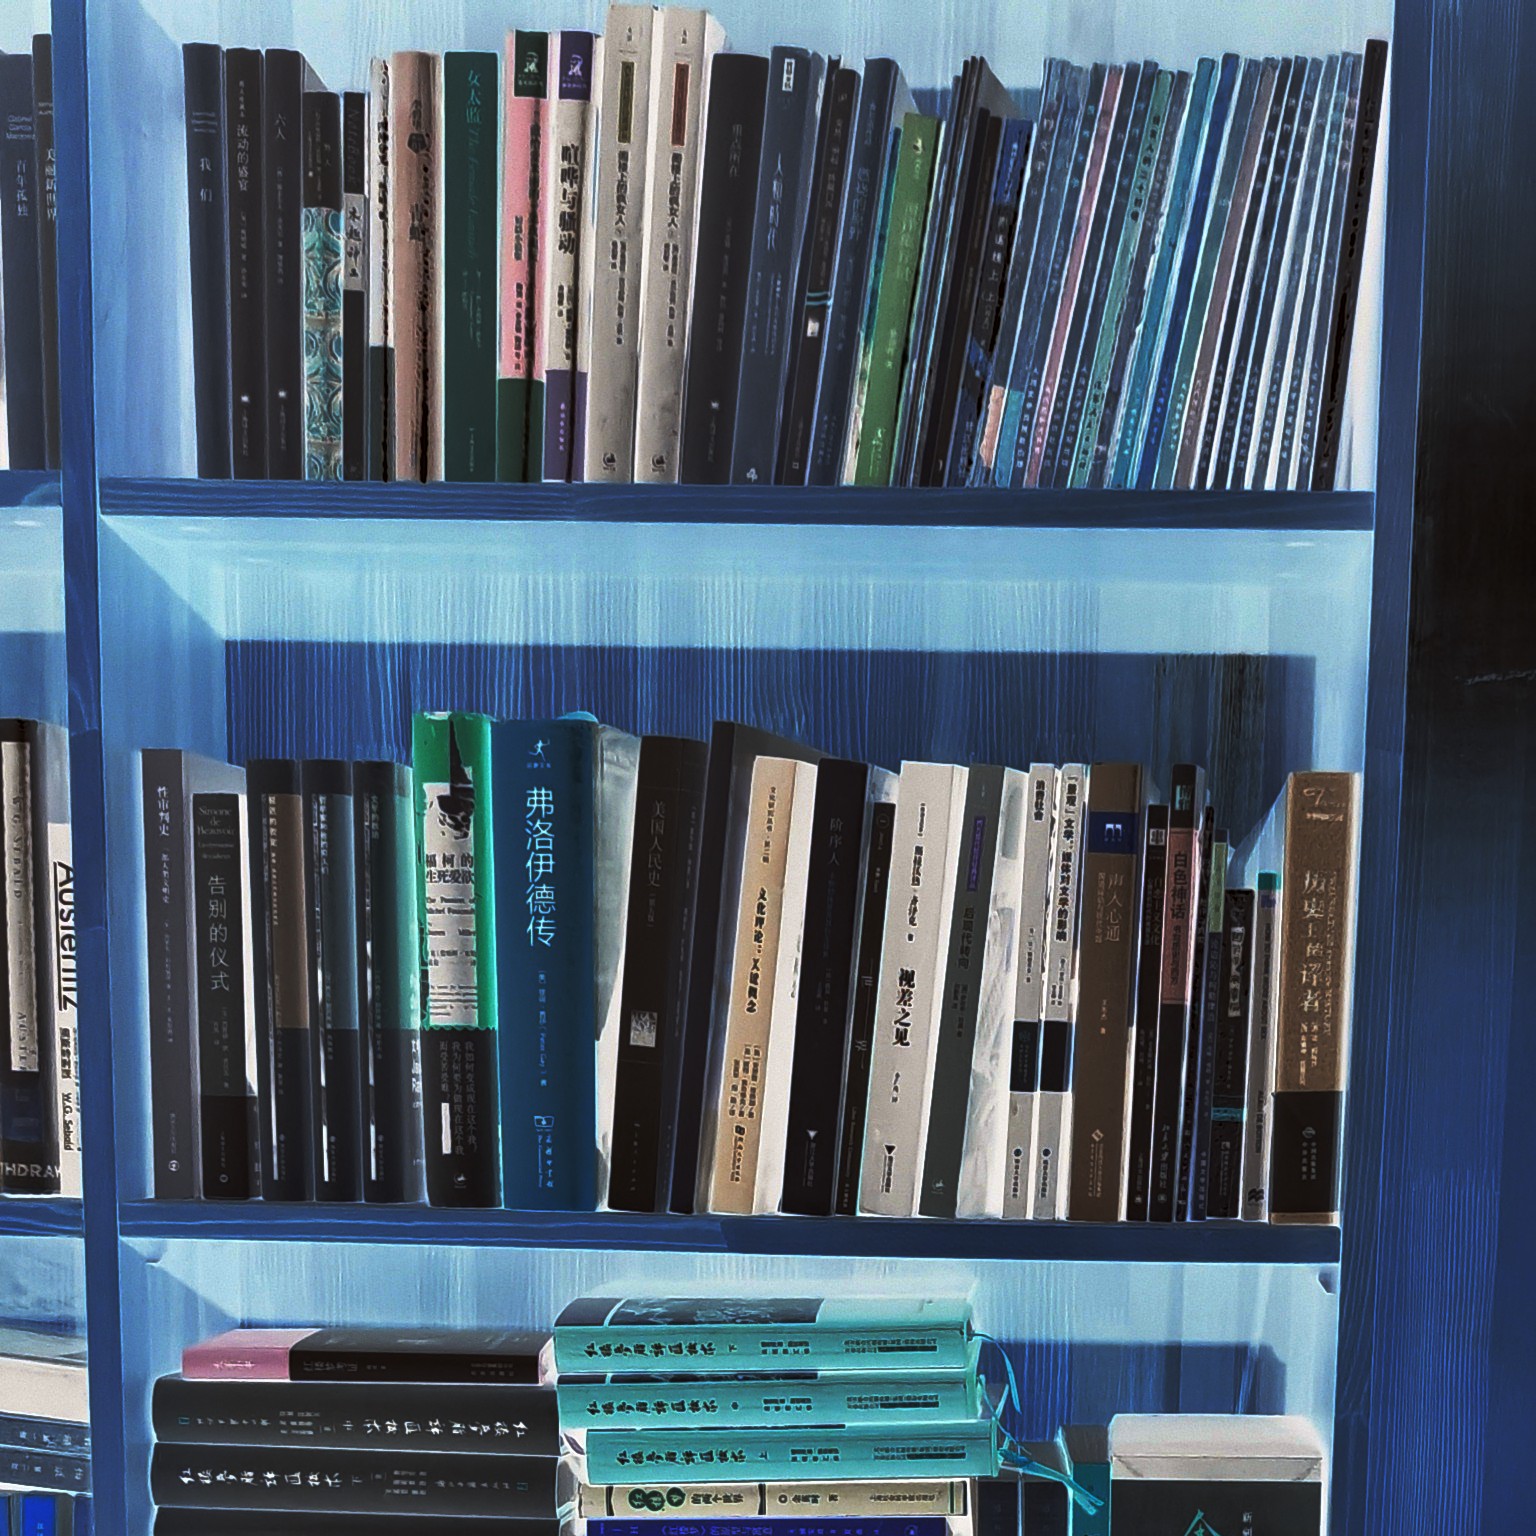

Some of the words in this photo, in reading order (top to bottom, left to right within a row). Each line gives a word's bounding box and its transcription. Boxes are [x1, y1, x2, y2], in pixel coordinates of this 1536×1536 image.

[16, 158, 29, 218] 百年孤独
[199, 156, 214, 203] 我们
[560, 144, 580, 256] 喧哗与骚动
[157, 785, 171, 838] 性审判史
[654, 799, 671, 889] 美国人民史
[525, 785, 560, 959] 弗洛伊德传
[1170, 851, 1188, 922] 白色神话
[207, 873, 233, 994] 告别的仪式
[892, 967, 918, 1049] 视差之见
